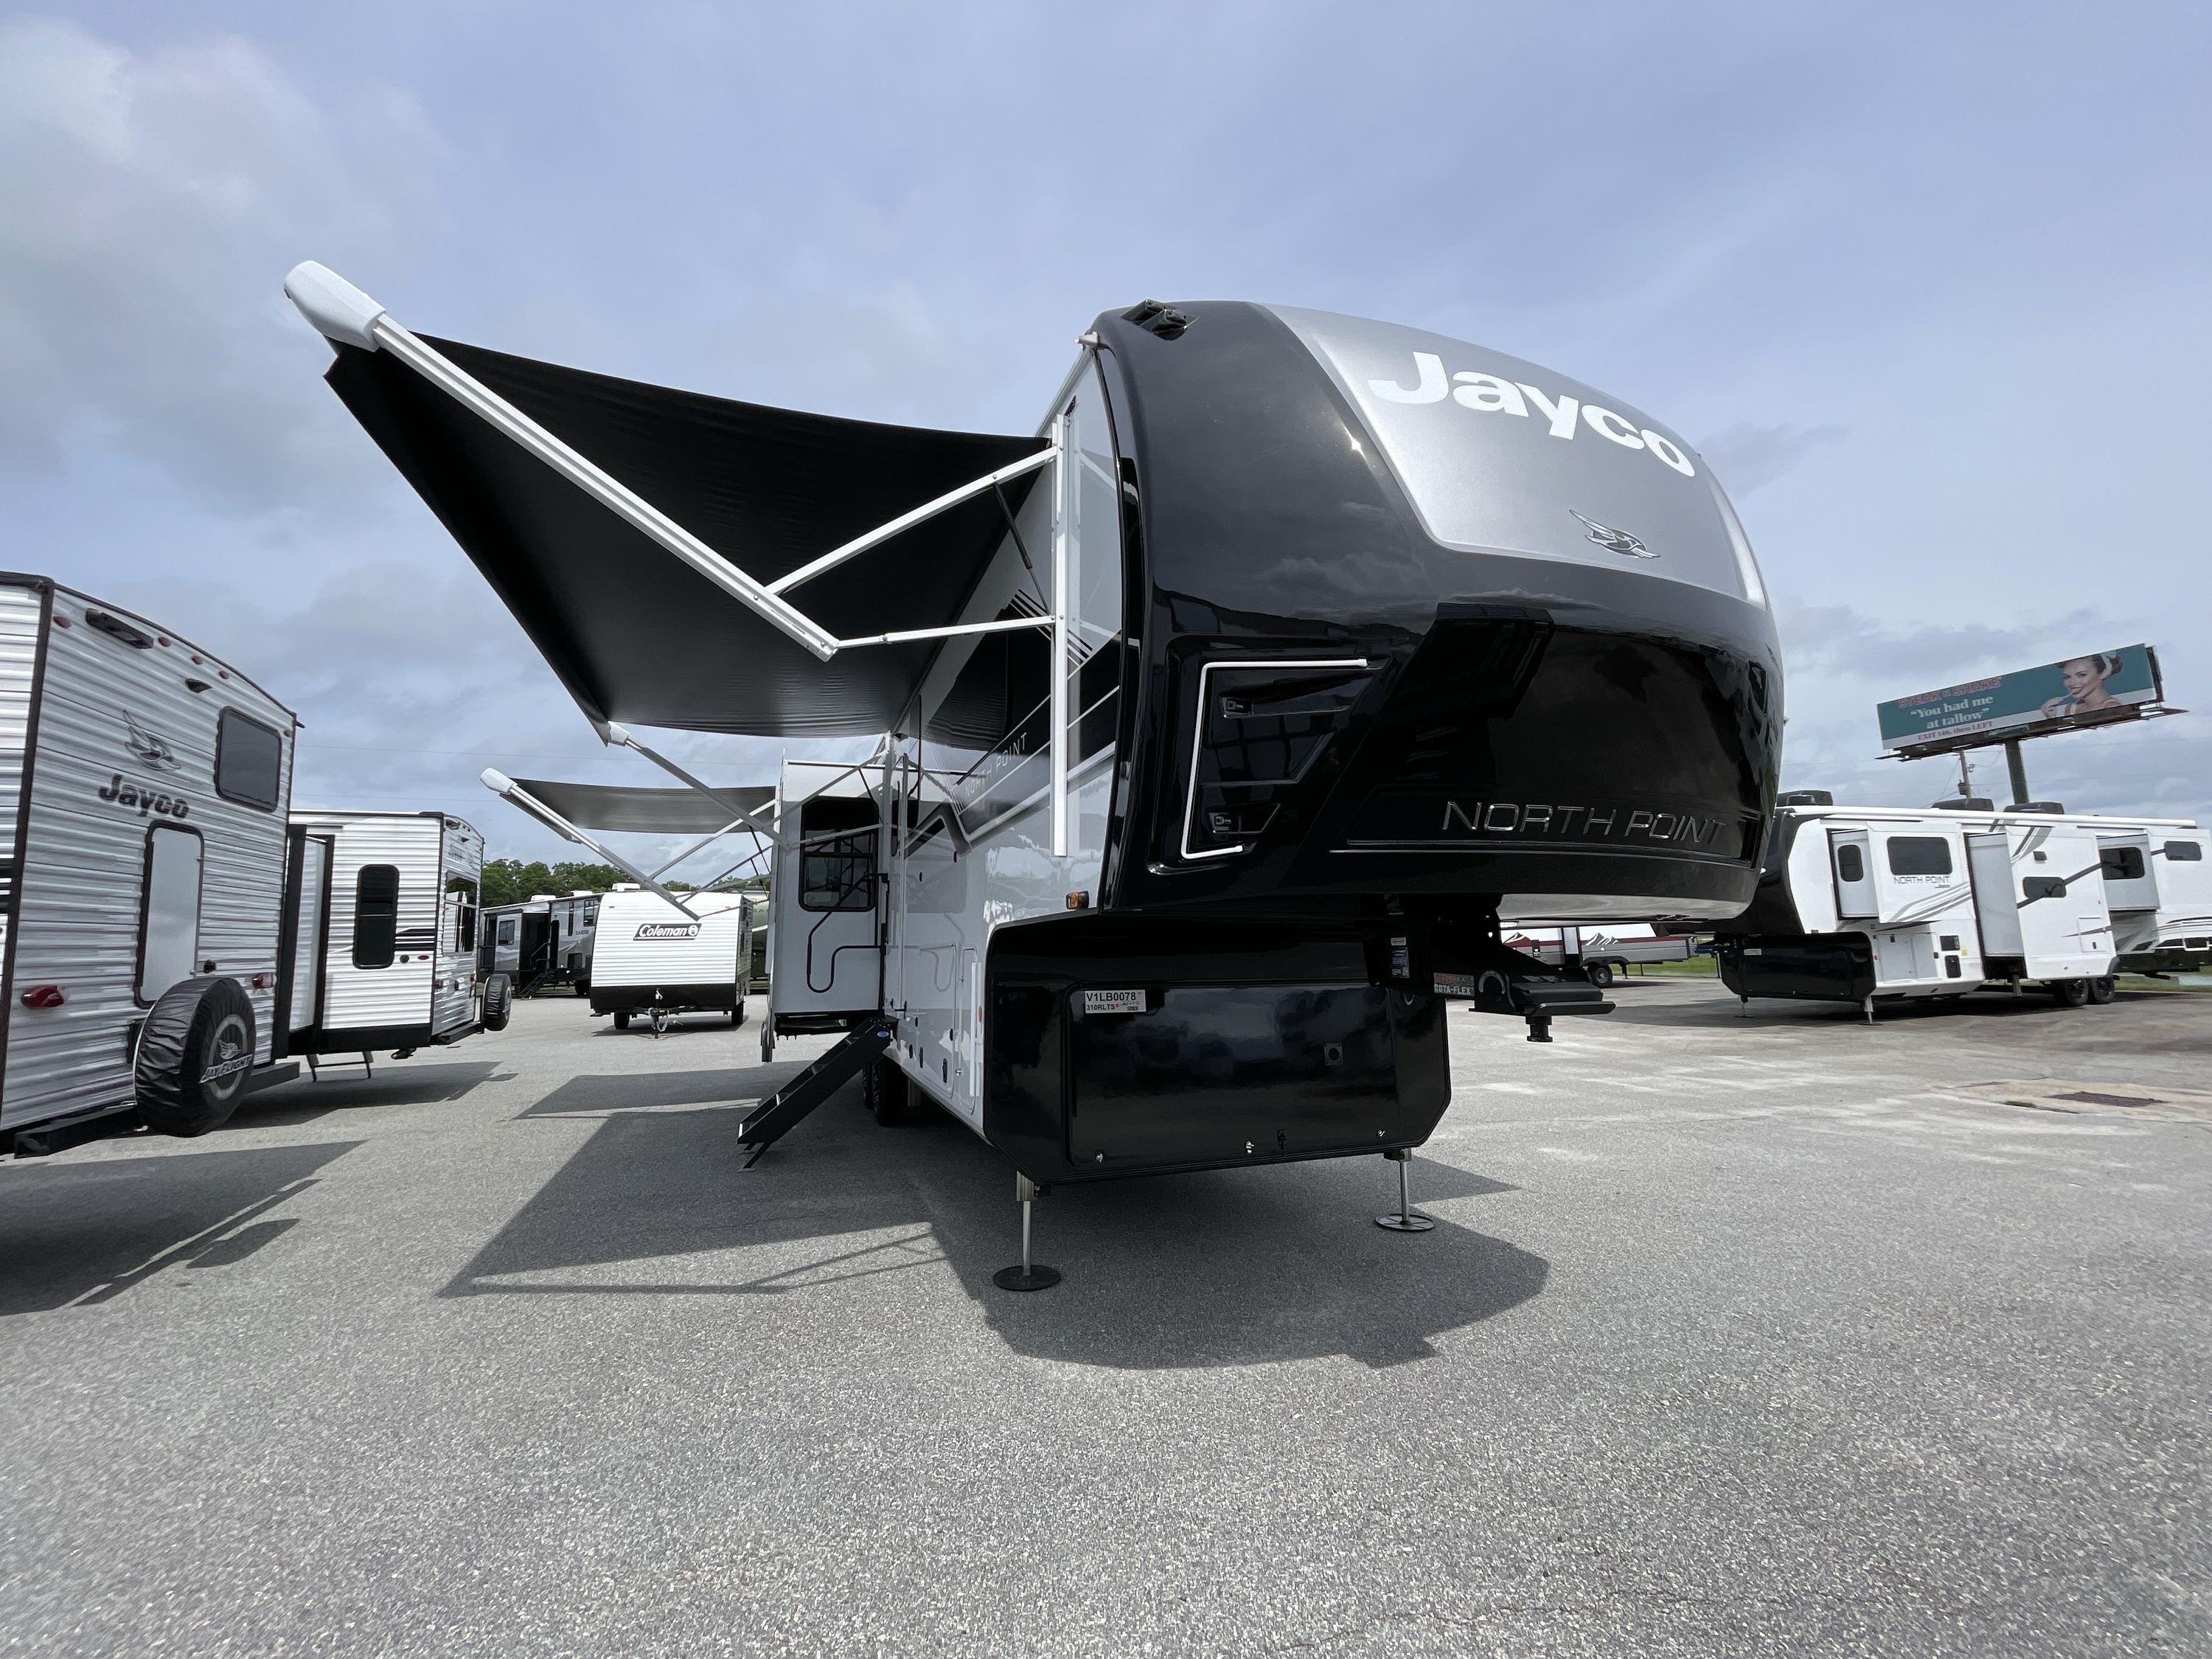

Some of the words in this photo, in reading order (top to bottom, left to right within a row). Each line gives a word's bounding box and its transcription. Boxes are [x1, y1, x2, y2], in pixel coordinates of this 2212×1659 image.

[1368, 351, 1695, 477] Jayco
[1952, 678, 2001, 697] SHAKE
[1944, 698, 1969, 713] had
[1972, 696, 1994, 707] me
[1918, 731, 1936, 740] EXIT
[1953, 726, 1971, 734] then
[1972, 721, 1993, 731] LEFT
[1927, 720, 1939, 729] at
[964, 763, 992, 799] NORTH
[996, 732, 1026, 773] POINT
[98, 773, 189, 818] Jayco
[1442, 801, 1618, 836] NORTH
[1624, 810, 1728, 844] POINT
[1893, 876, 1923, 884] NORTH
[639, 924, 687, 938] Coleman
[1086, 992, 1136, 1001] V1LB0078
